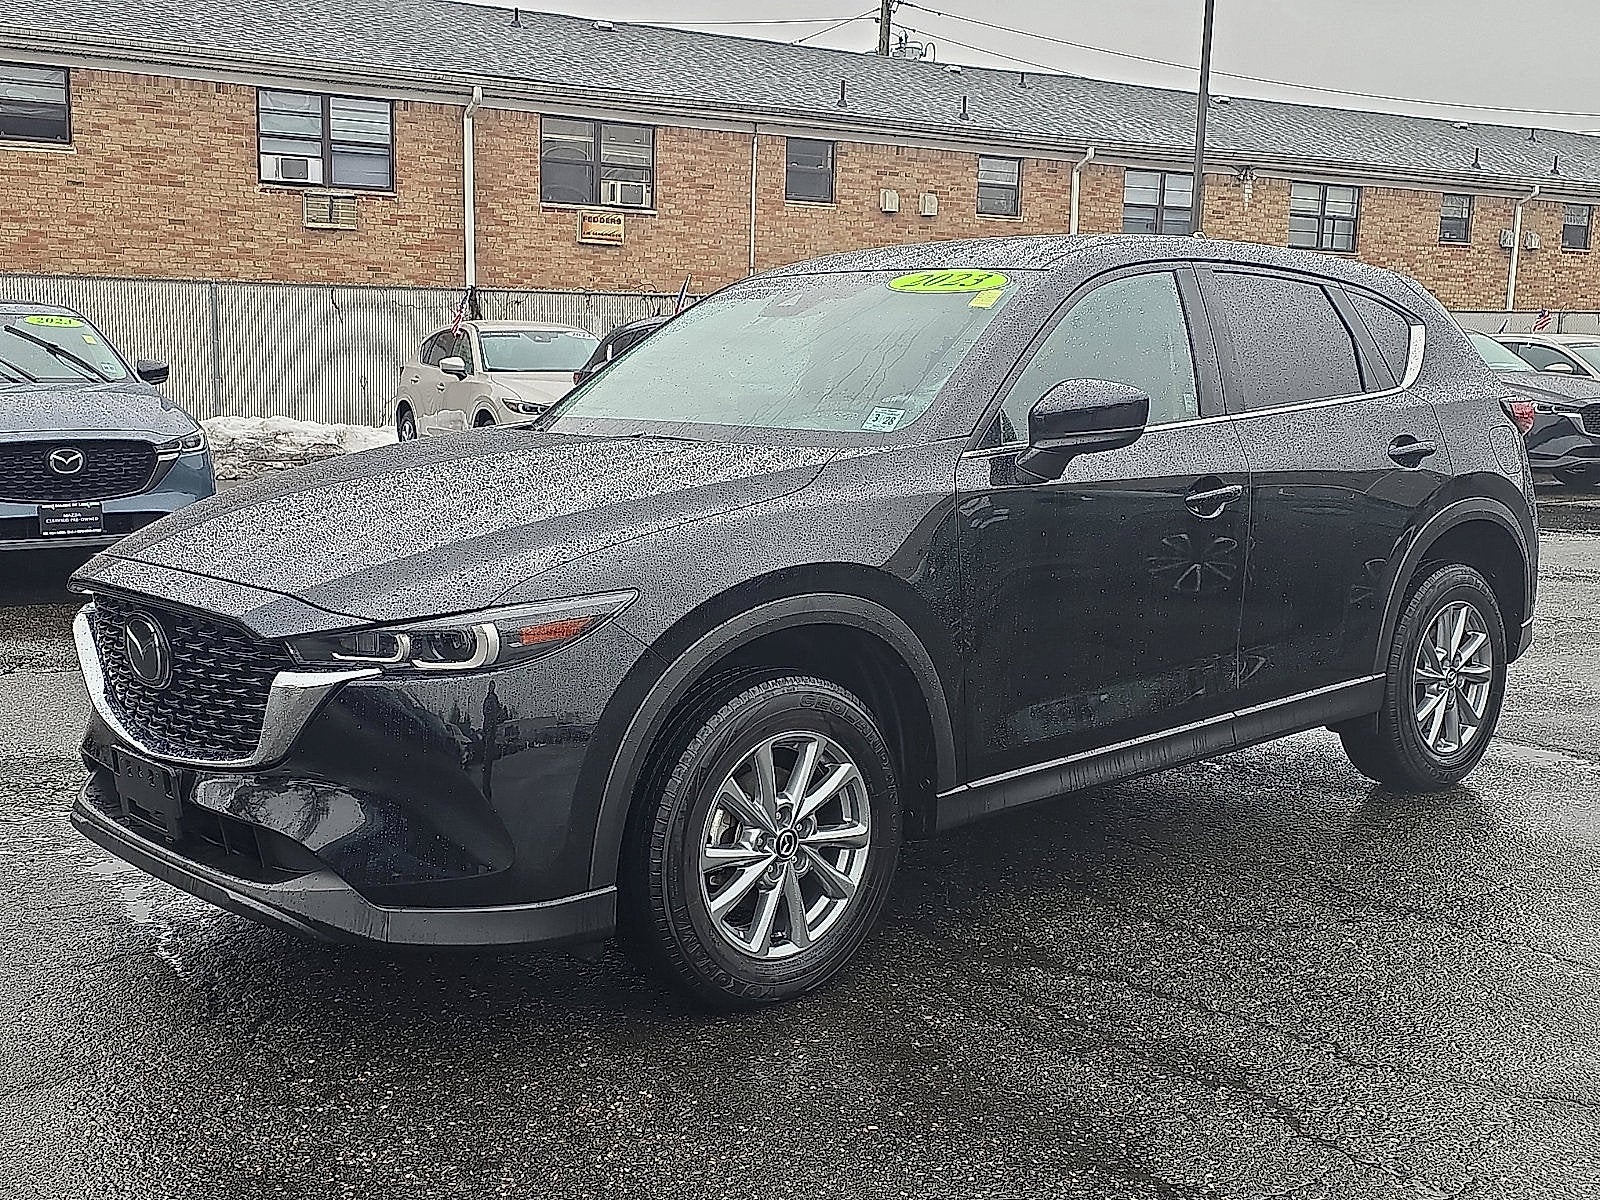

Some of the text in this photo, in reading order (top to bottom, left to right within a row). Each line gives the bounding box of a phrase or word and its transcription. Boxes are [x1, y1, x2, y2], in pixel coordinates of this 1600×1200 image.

[582, 215, 622, 225] FEDDERS
[900, 273, 994, 287] 2023
[871, 413, 881, 422] 3
